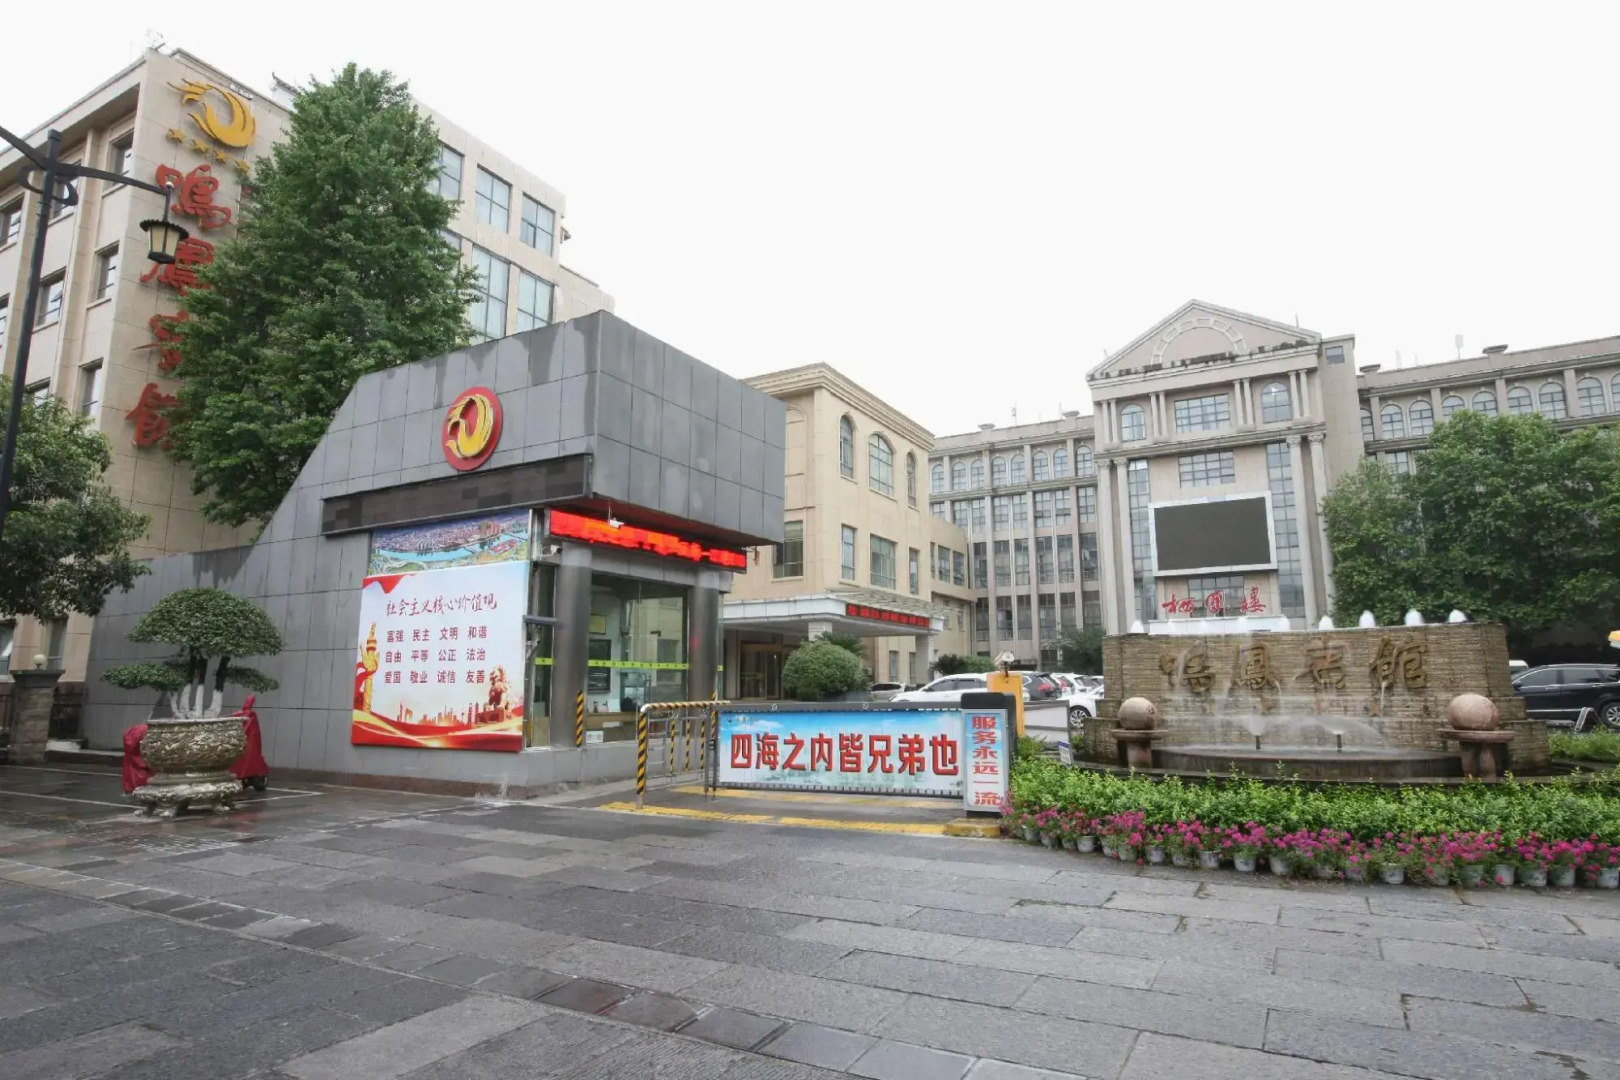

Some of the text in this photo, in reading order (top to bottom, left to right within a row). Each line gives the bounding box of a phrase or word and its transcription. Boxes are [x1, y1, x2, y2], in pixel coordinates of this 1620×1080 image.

[386, 593, 497, 616] 社会主义核心价值观
[387, 625, 487, 643] 富强 民主 文明 和谐
[385, 647, 486, 663] 自由 平等 公正 法治
[384, 669, 485, 683] 爱国 敬业 诚信 友善
[731, 732, 959, 776] 四海之内皆兄弟也
[971, 715, 1001, 806] 服务永远一流
